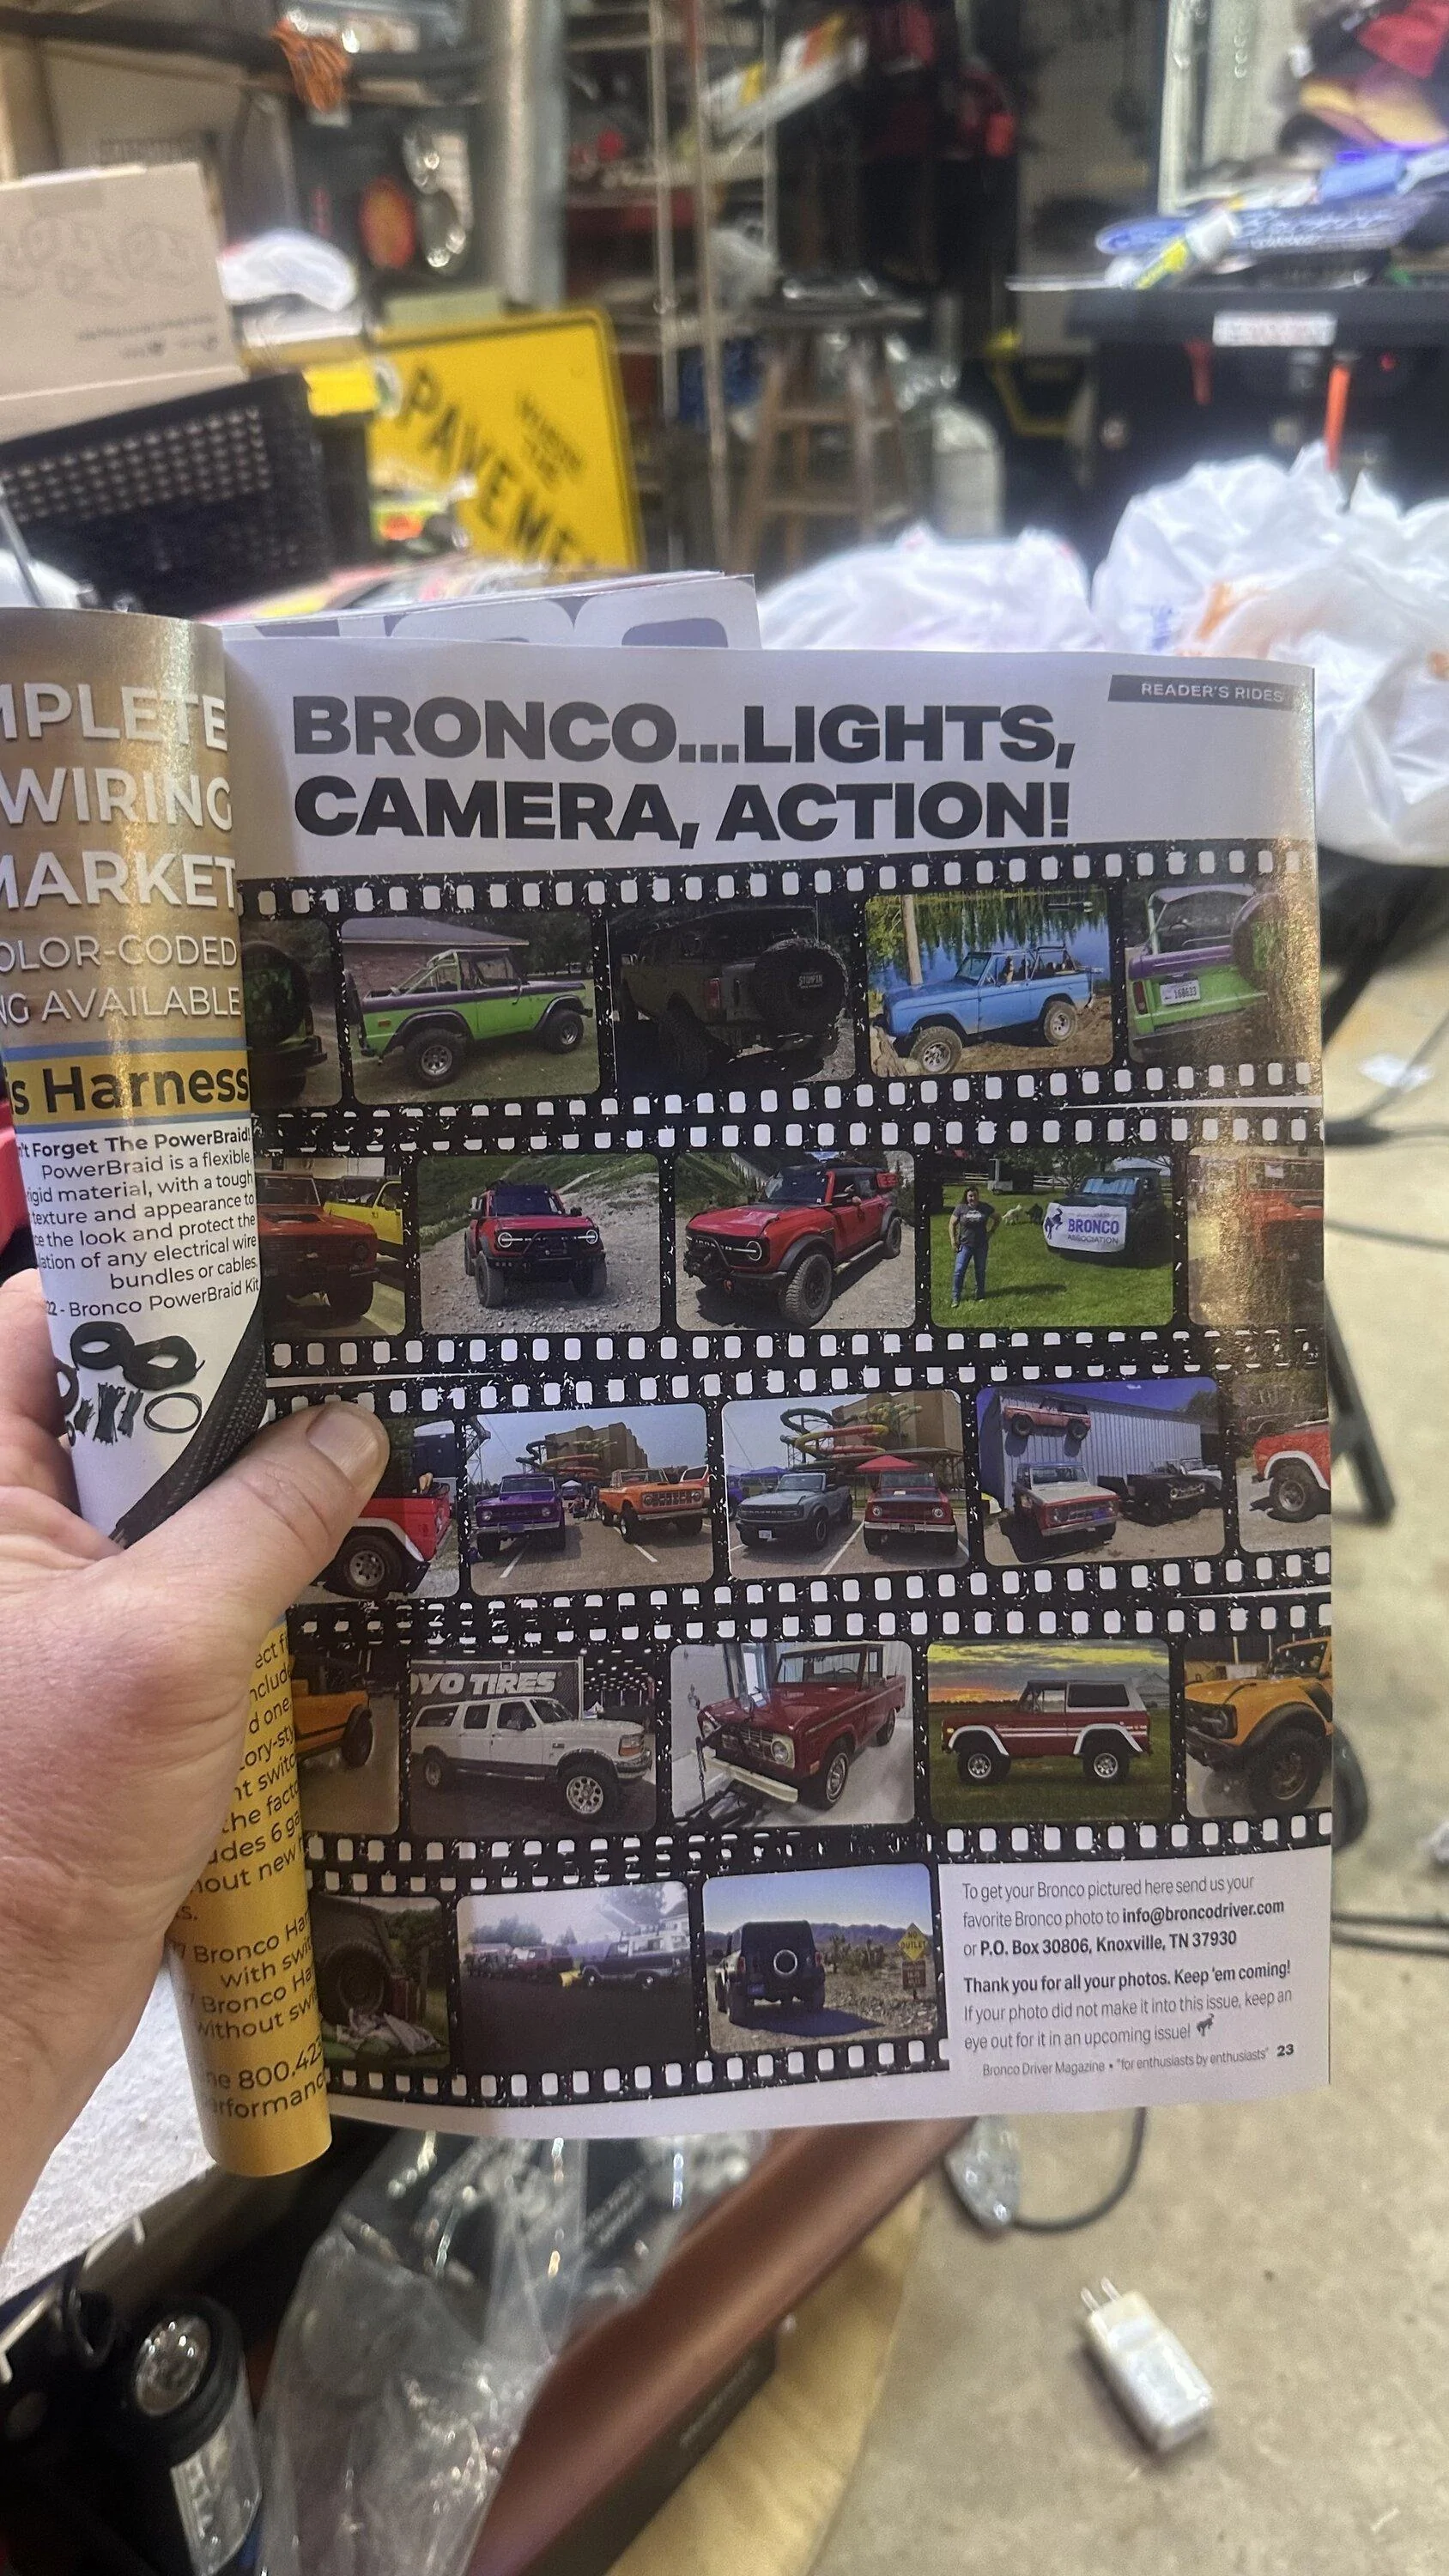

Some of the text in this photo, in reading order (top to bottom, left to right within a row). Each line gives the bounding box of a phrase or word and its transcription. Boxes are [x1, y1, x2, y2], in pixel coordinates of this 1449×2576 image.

[1141, 683, 1284, 703] READER'S RIDES
[0, 767, 233, 833] WIRING
[294, 775, 1070, 850] CAMERA, ACTION!
[41, 985, 241, 1022] AVAILABLE
[43, 1066, 249, 1113] Harness
[32, 1139, 100, 1159] Forget
[104, 1135, 149, 1152] The
[155, 1126, 252, 1149] PowerBraid!
[41, 1148, 252, 1180] PowerBraid is a flexible,
[58, 1179, 153, 1202] material,
[157, 1175, 199, 1194] with
[203, 1177, 213, 1189] a
[215, 1169, 254, 1188] tough
[32, 1193, 255, 1226] texture and appearance to
[46, 1231, 74, 1248] the
[79, 1227, 127, 1246] look
[132, 1221, 173, 1242] and
[179, 1215, 234, 1240] protect
[237, 1212, 256, 1228] the
[1067, 1218, 1119, 1235] BRONCO
[1067, 1234, 1119, 1244] ASSOCIATION
[81, 1251, 102, 1268] of
[106, 1251, 148, 1268] any
[153, 1236, 229, 1262] electrical
[232, 1233, 257, 1251] wire
[109, 1256, 258, 1290] bundles or cables.
[69, 1300, 142, 1318] Bronco
[149, 1279, 242, 1311] PowerBraid
[245, 1276, 259, 1294] Kit
[470, 1671, 557, 1696] TIRES
[271, 1822, 282, 1843] 6
[258, 1844, 296, 1881] new
[962, 1875, 1255, 1903] To get your Bronco pictured here send us your
[962, 1900, 1285, 1929] favorite Bronco photo to info@broncodriver.com
[193, 1934, 279, 1964] Bronco
[963, 1929, 1237, 1957] or P.O. Box 30806, Knoxville, TN 37930
[221, 1961, 276, 1989] with
[963, 1959, 1291, 1996] Thank you for all your photos. Keep 'em coming!
[202, 1986, 287, 2014] Bronco
[964, 1988, 1293, 2025] If your photo did not make it into this issue, keep an
[964, 2034, 988, 2053] eye
[990, 2032, 1014, 2049] out
[1016, 2031, 1035, 2048] for
[1037, 2030, 1046, 2047] it
[1048, 2029, 1062, 2046] in
[1064, 2032, 1082, 2046] an
[1083, 2025, 1152, 2049] upcoming
[982, 2062, 1021, 2078] Bronco
[1022, 2062, 1053, 2076] Driver
[1054, 2061, 1106, 2075] Magazine
[1137, 2054, 1195, 2070] enthusiasts
[1195, 2052, 1208, 2068] by
[1276, 2043, 1294, 2057] 23
